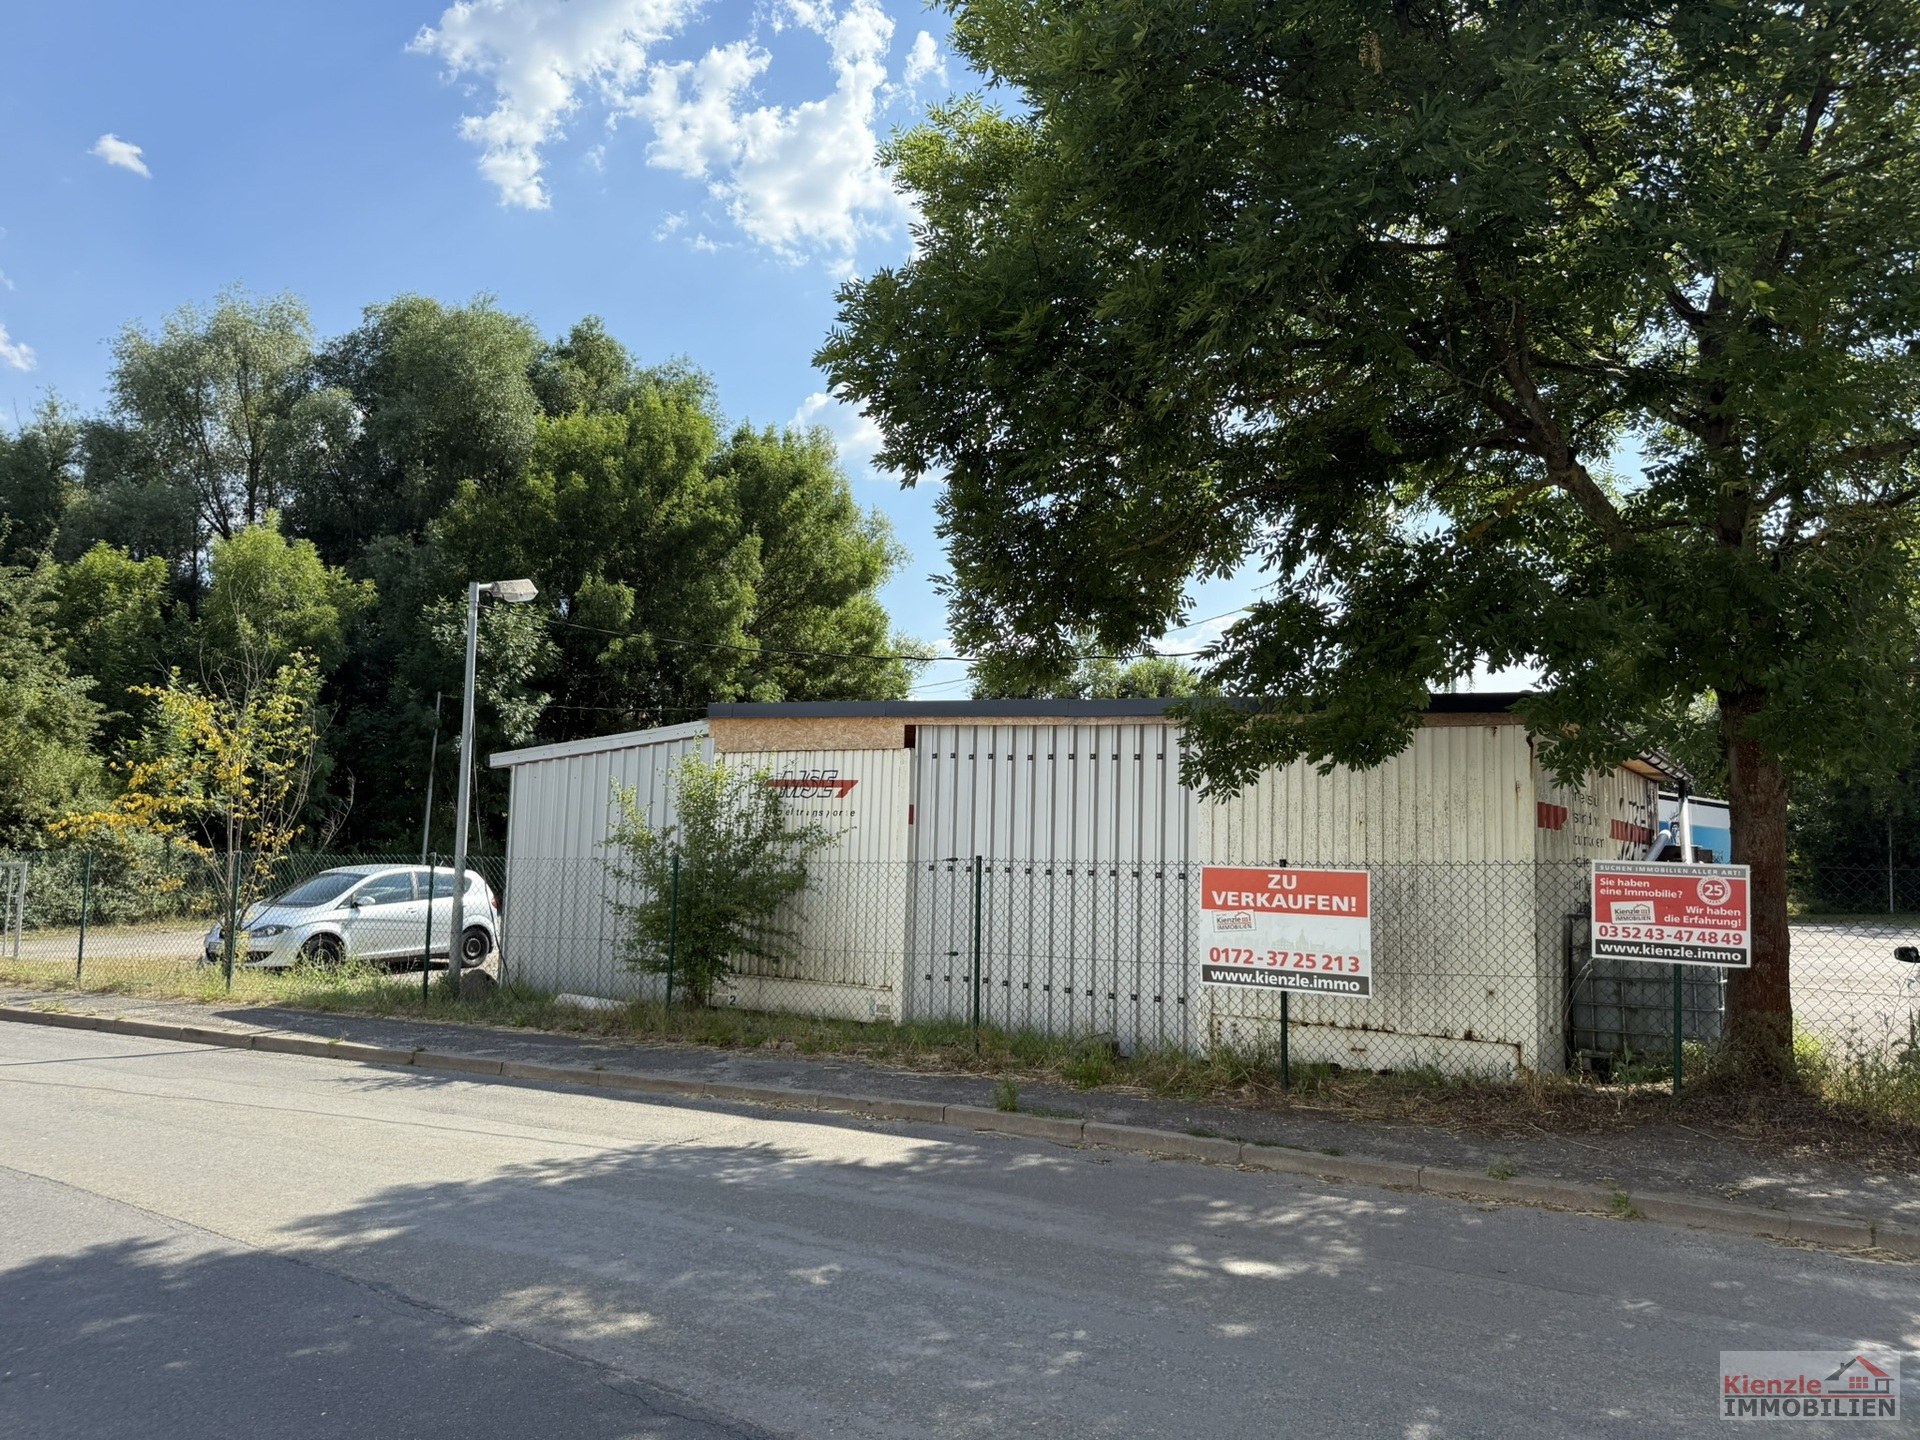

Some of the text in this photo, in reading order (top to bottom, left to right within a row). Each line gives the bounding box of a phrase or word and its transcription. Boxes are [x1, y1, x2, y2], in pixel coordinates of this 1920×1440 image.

[1635, 866, 1688, 875] IMMOBILIEN
[1691, 868, 1718, 876] ALLER
[1267, 873, 1297, 889] ZU
[1599, 877, 1615, 887] Sie
[1617, 878, 1650, 888] haben
[1599, 887, 1683, 899] eine Immobilie?
[1704, 884, 1723, 897] 25
[1211, 890, 1357, 912] VERKAUFEN!
[1685, 905, 1741, 917] Wir haben
[1216, 916, 1241, 924] Kienzle
[1664, 914, 1741, 928] die Erfahrung!
[1217, 923, 1252, 931] IMMOBILIEN
[1600, 943, 1742, 961] www.kienzle.immo
[1210, 969, 1360, 992] www.kienzle.immo
